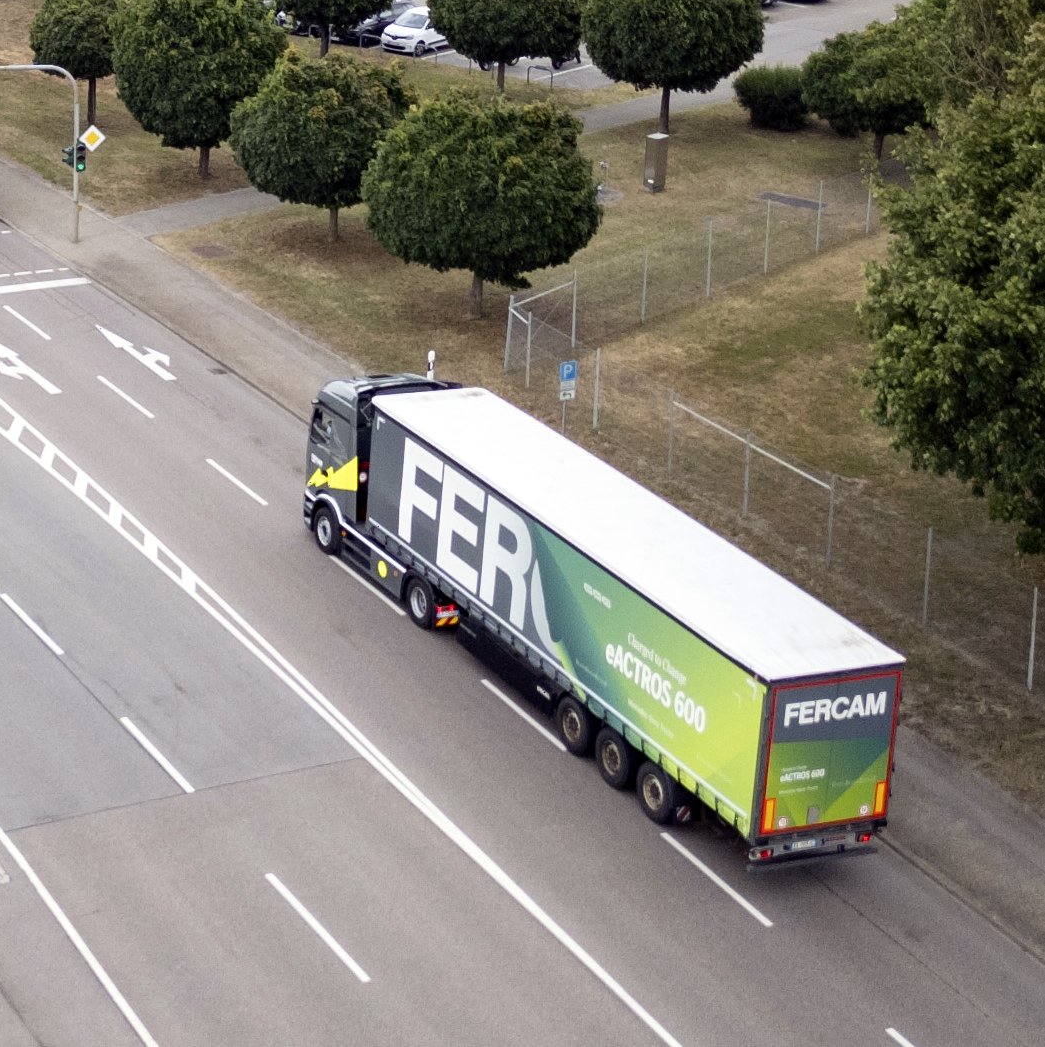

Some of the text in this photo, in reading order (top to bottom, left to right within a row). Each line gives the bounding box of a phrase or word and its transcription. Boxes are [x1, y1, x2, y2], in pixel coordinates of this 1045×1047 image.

[563, 364, 573, 378] P
[605, 643, 672, 708] eACTROS
[674, 690, 706, 733] 600
[783, 691, 887, 728] FERCAM
[780, 770, 810, 782] eACTROS
